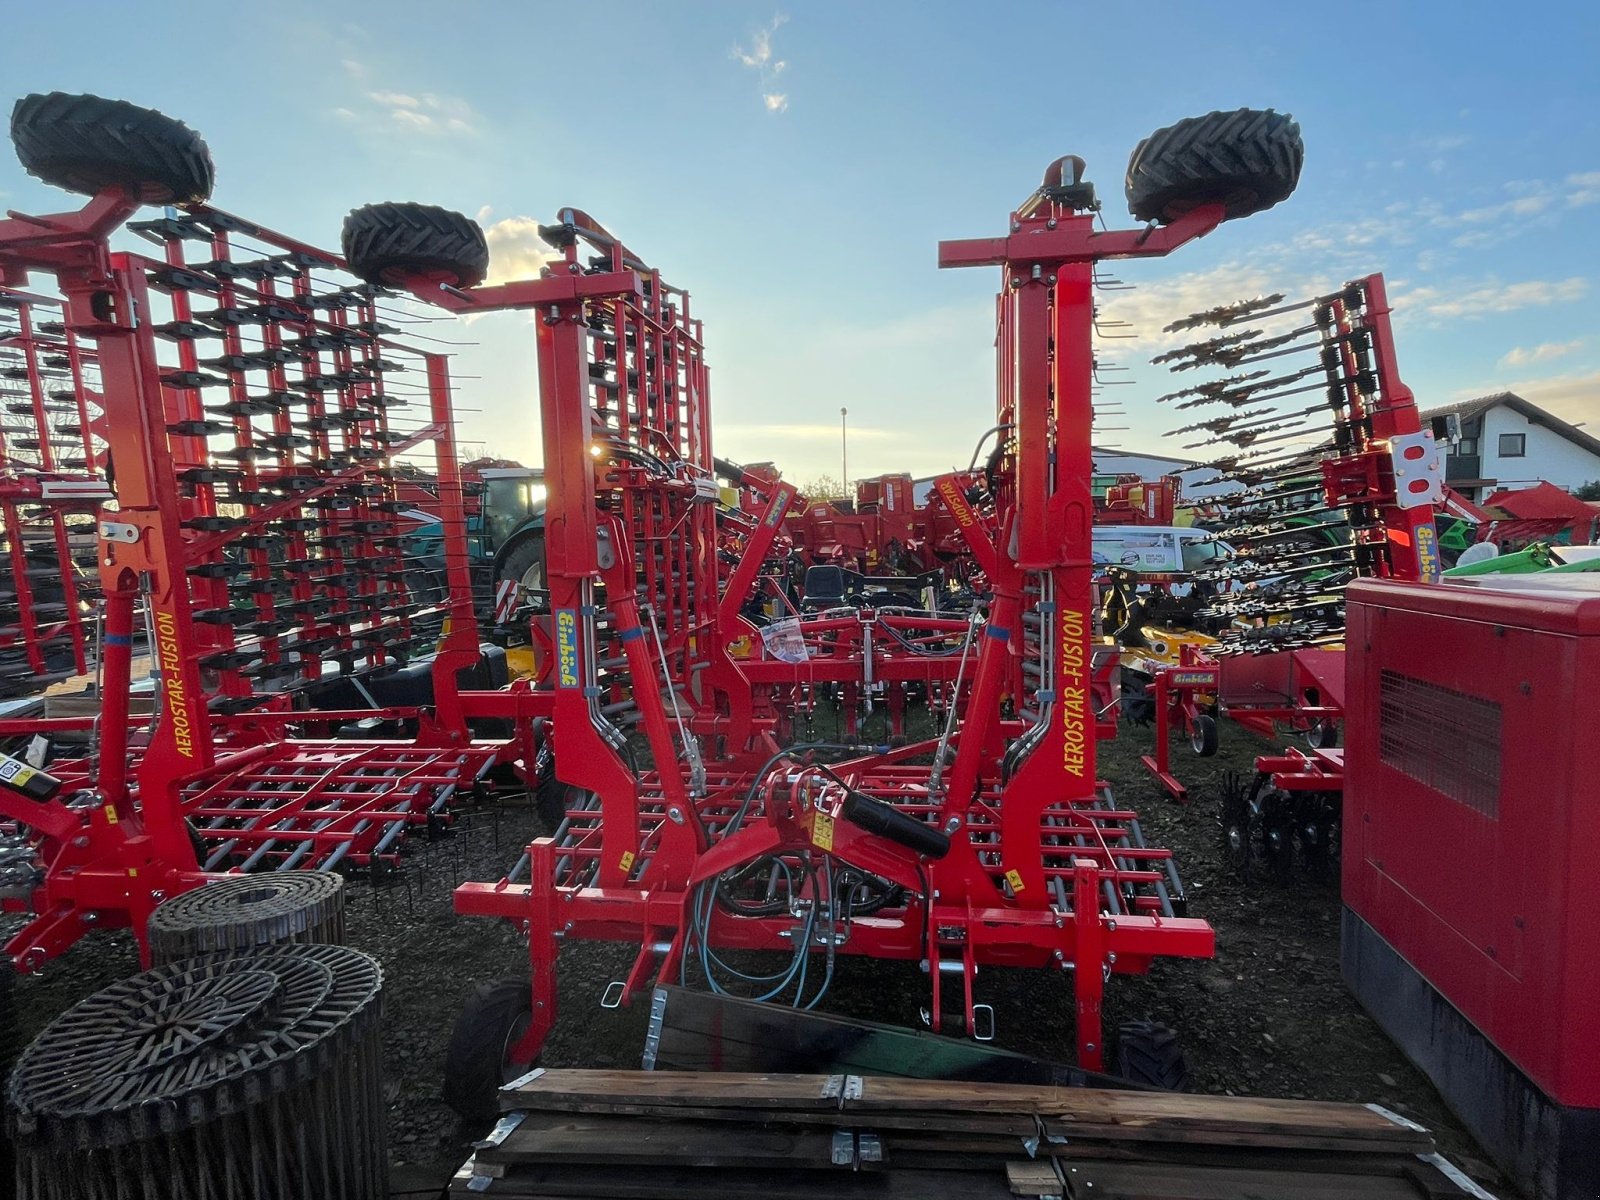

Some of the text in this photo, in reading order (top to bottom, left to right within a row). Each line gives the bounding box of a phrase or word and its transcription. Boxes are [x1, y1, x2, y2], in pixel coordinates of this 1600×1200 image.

[940, 481, 974, 527] CHOPSTAR
[157, 611, 193, 758] AEROSTAR-FUSION
[558, 612, 577, 686] Einböck
[1063, 609, 1085, 777] AEROSTAR-FUSION
